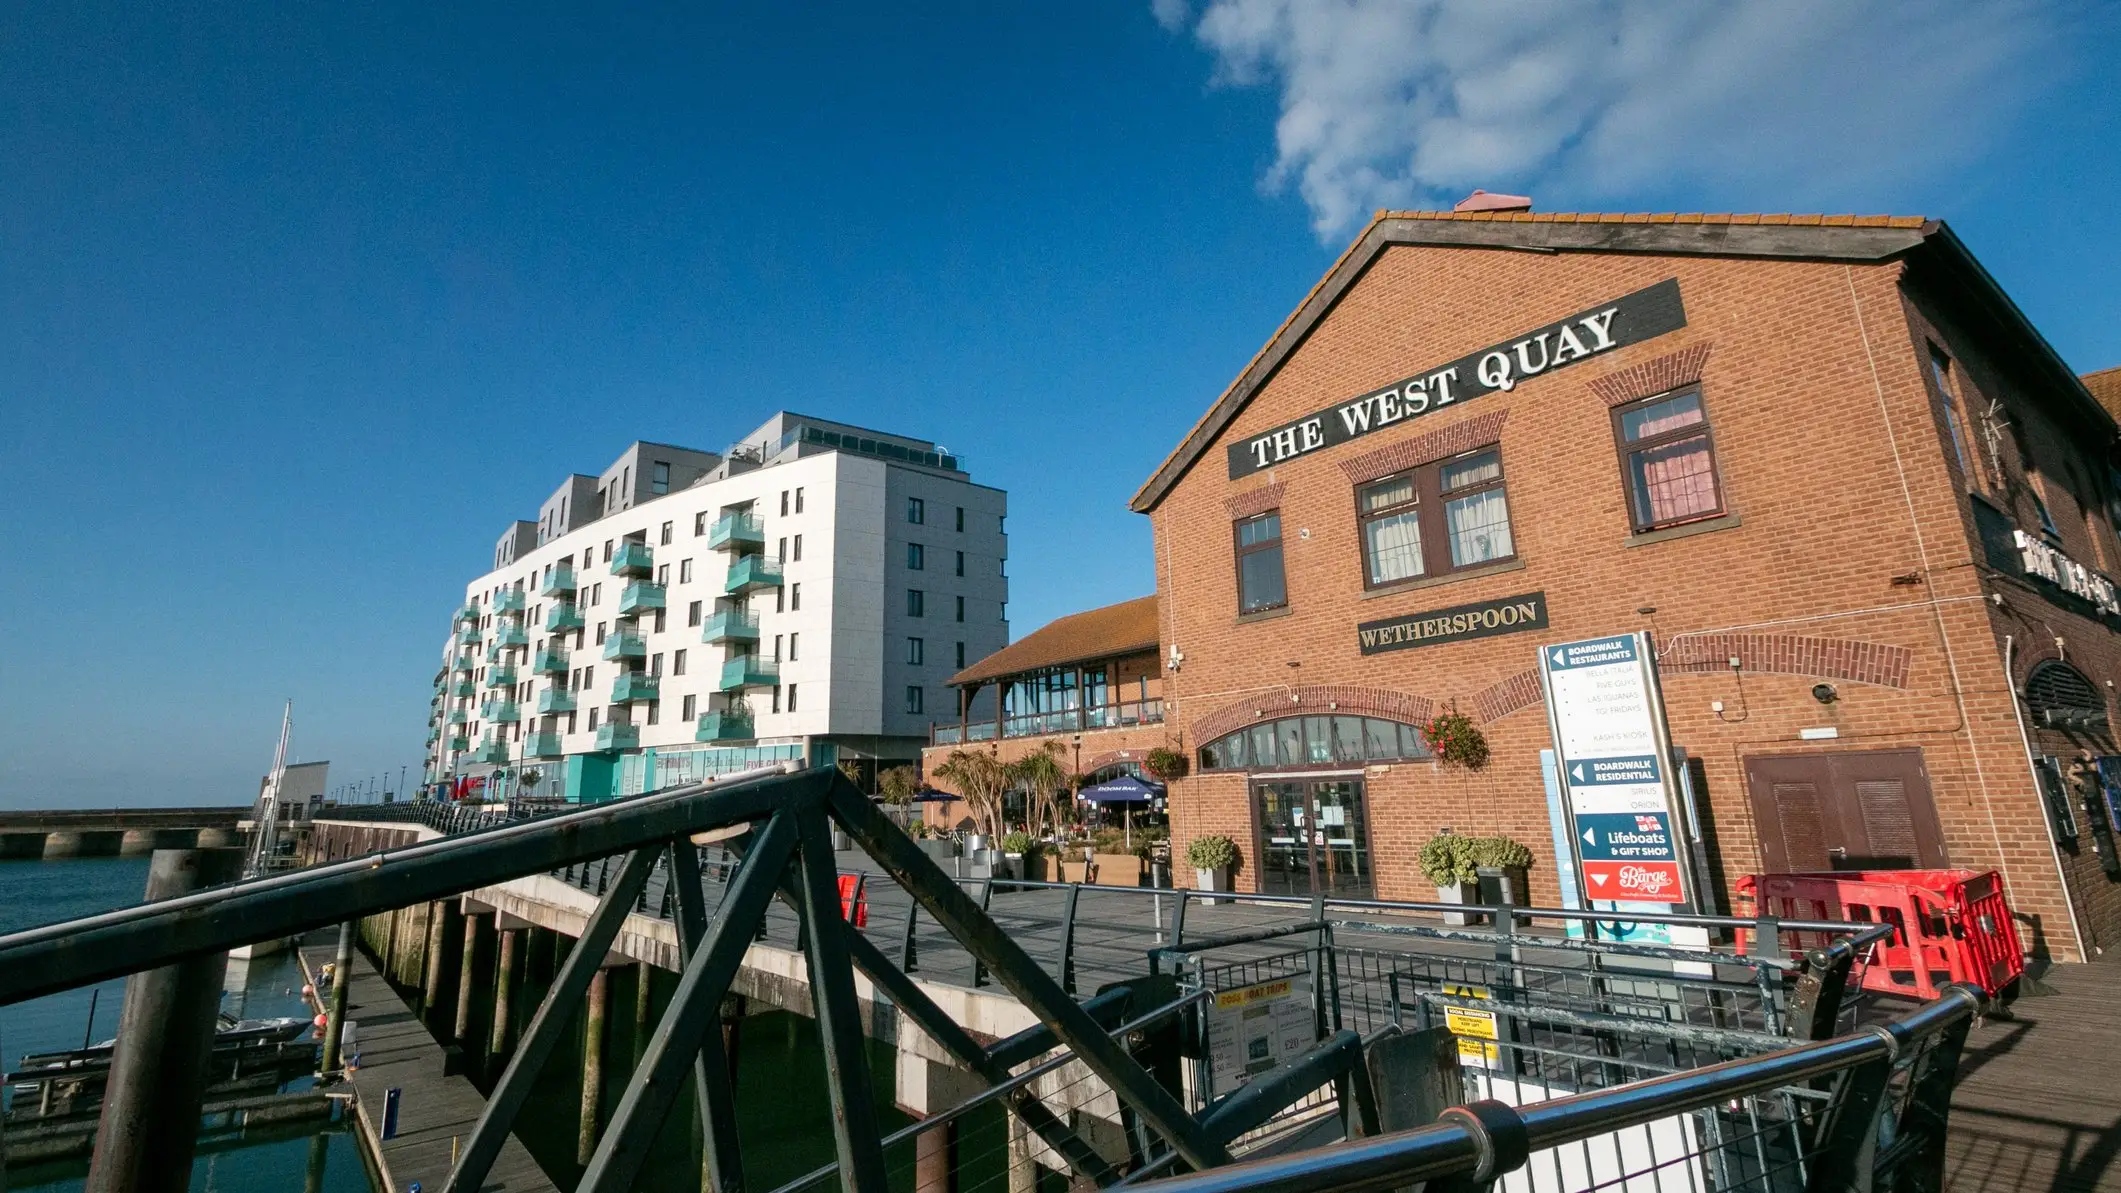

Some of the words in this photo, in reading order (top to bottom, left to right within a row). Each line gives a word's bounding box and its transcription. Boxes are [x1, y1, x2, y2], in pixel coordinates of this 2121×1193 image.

[1251, 417, 1325, 468] THE
[1338, 366, 1460, 436] WEST
[1477, 307, 1618, 391] QUAY
[1360, 601, 1537, 648] WETHERSPOON
[1568, 641, 1623, 656] BOARDWALK
[1569, 650, 1632, 665] RESTAURANTS
[1586, 668, 1608, 678] BELLA
[1610, 665, 1634, 675] ITALIA
[1596, 680, 1613, 689] FIVE
[1614, 678, 1637, 688] GUYS
[1587, 695, 1602, 704] LAS
[1604, 692, 1640, 702] IGUANAS
[1609, 704, 1642, 714] FRIDAYS
[1623, 730, 1648, 740] KIOSK
[1593, 760, 1652, 771] BOARDWALK
[1595, 772, 1655, 782] RESIDENTIAL
[1631, 787, 1657, 796] SIRIUS
[1631, 801, 1660, 810] ORION
[1608, 832, 1666, 844] Lifeboats
[1611, 847, 1618, 856] &
[1619, 847, 1640, 856] GIFT
[1642, 847, 1669, 856] SHOP
[1619, 865, 1668, 894] Barge
